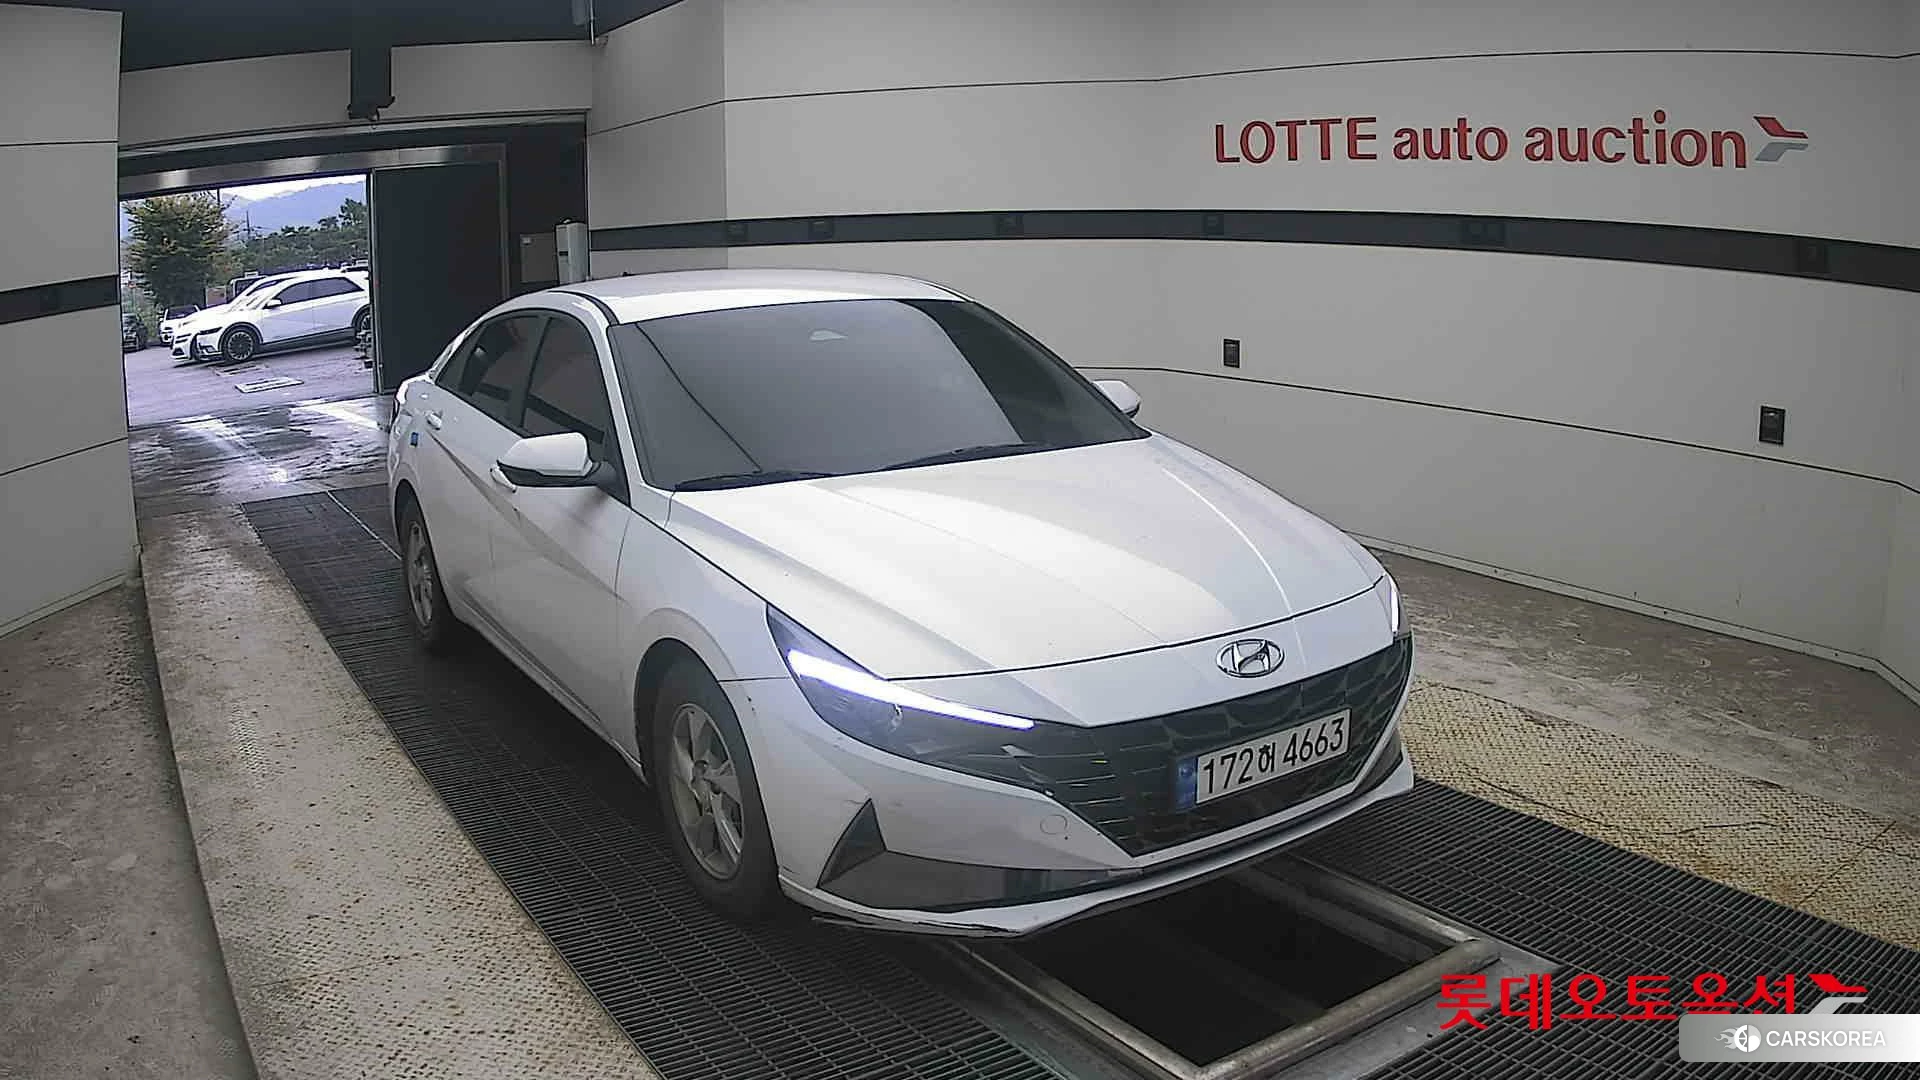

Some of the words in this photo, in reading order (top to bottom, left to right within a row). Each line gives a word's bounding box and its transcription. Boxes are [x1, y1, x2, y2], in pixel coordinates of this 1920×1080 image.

[1214, 116, 1377, 164] LOTTE
[1392, 117, 1509, 162] auto
[1523, 110, 1747, 168] auction
[1203, 742, 1277, 794] 172허
[1283, 717, 1345, 766] 4663
